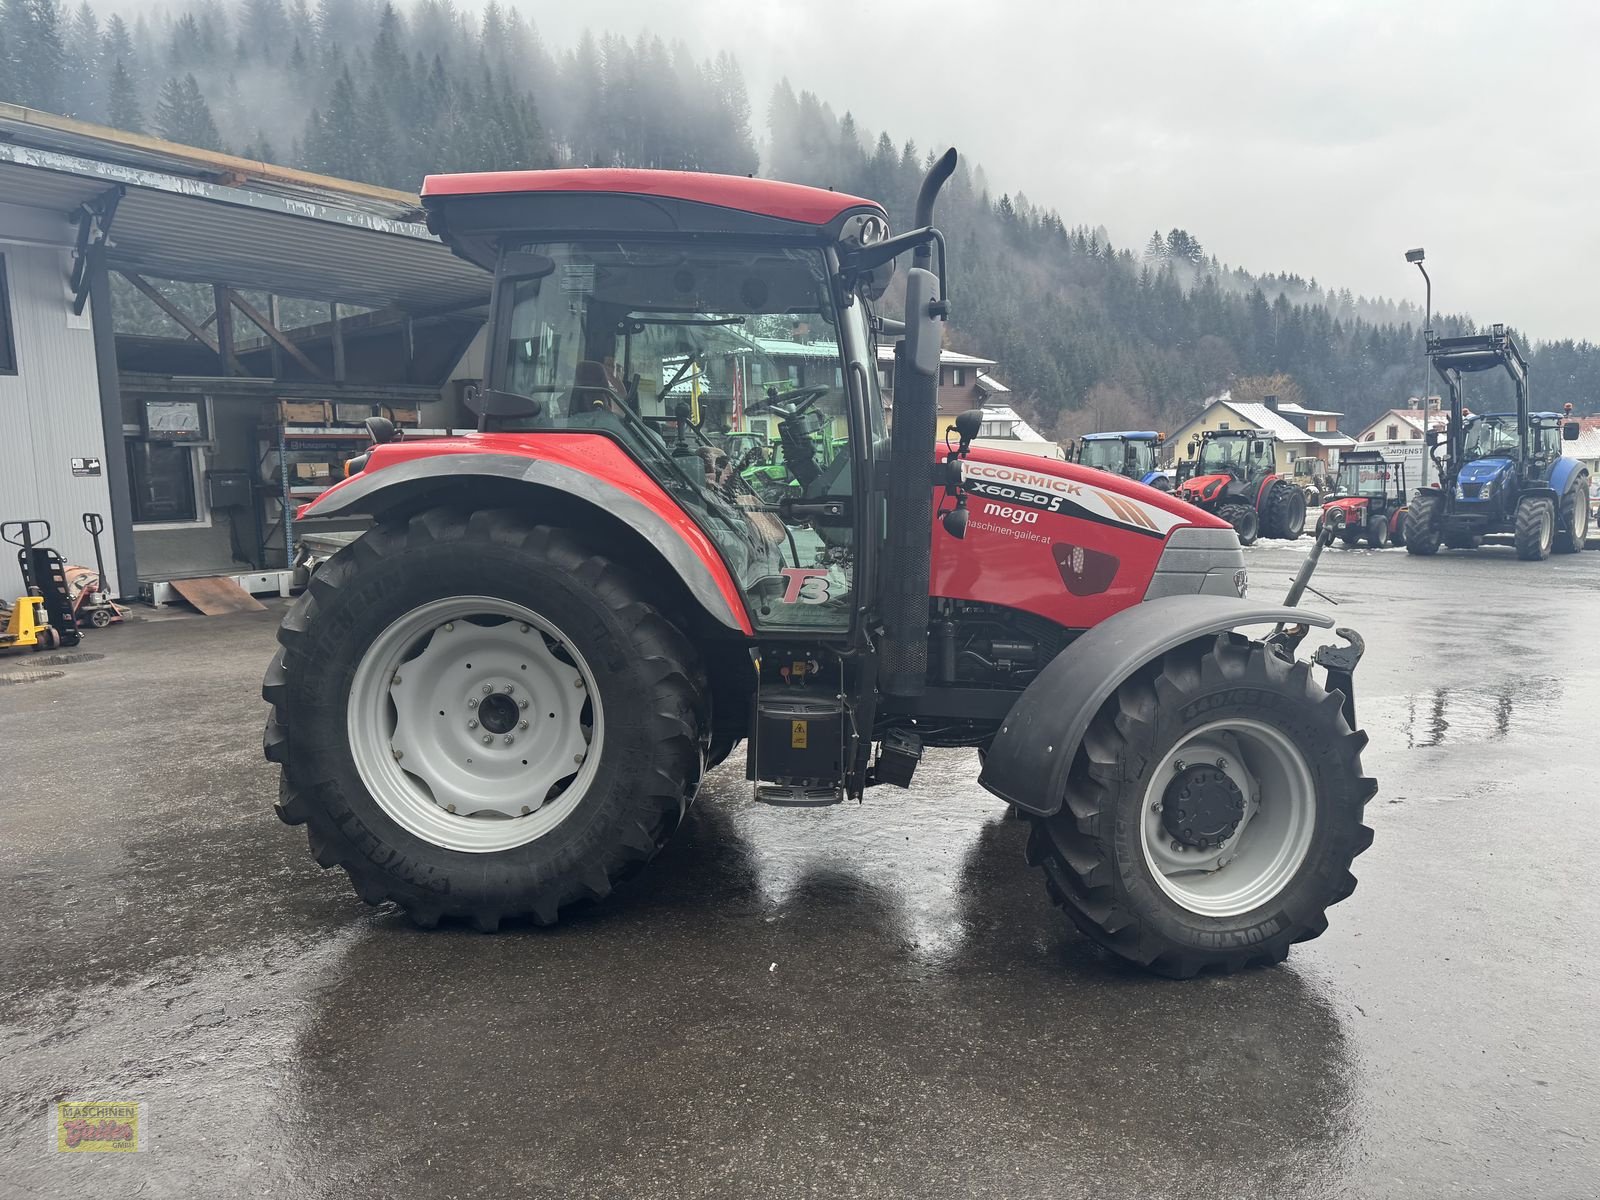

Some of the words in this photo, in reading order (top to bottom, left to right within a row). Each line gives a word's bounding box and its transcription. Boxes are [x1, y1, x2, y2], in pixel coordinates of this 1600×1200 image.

[971, 481, 1049, 505] X60.50
[983, 502, 1039, 524] mega
[780, 567, 831, 605] T3
